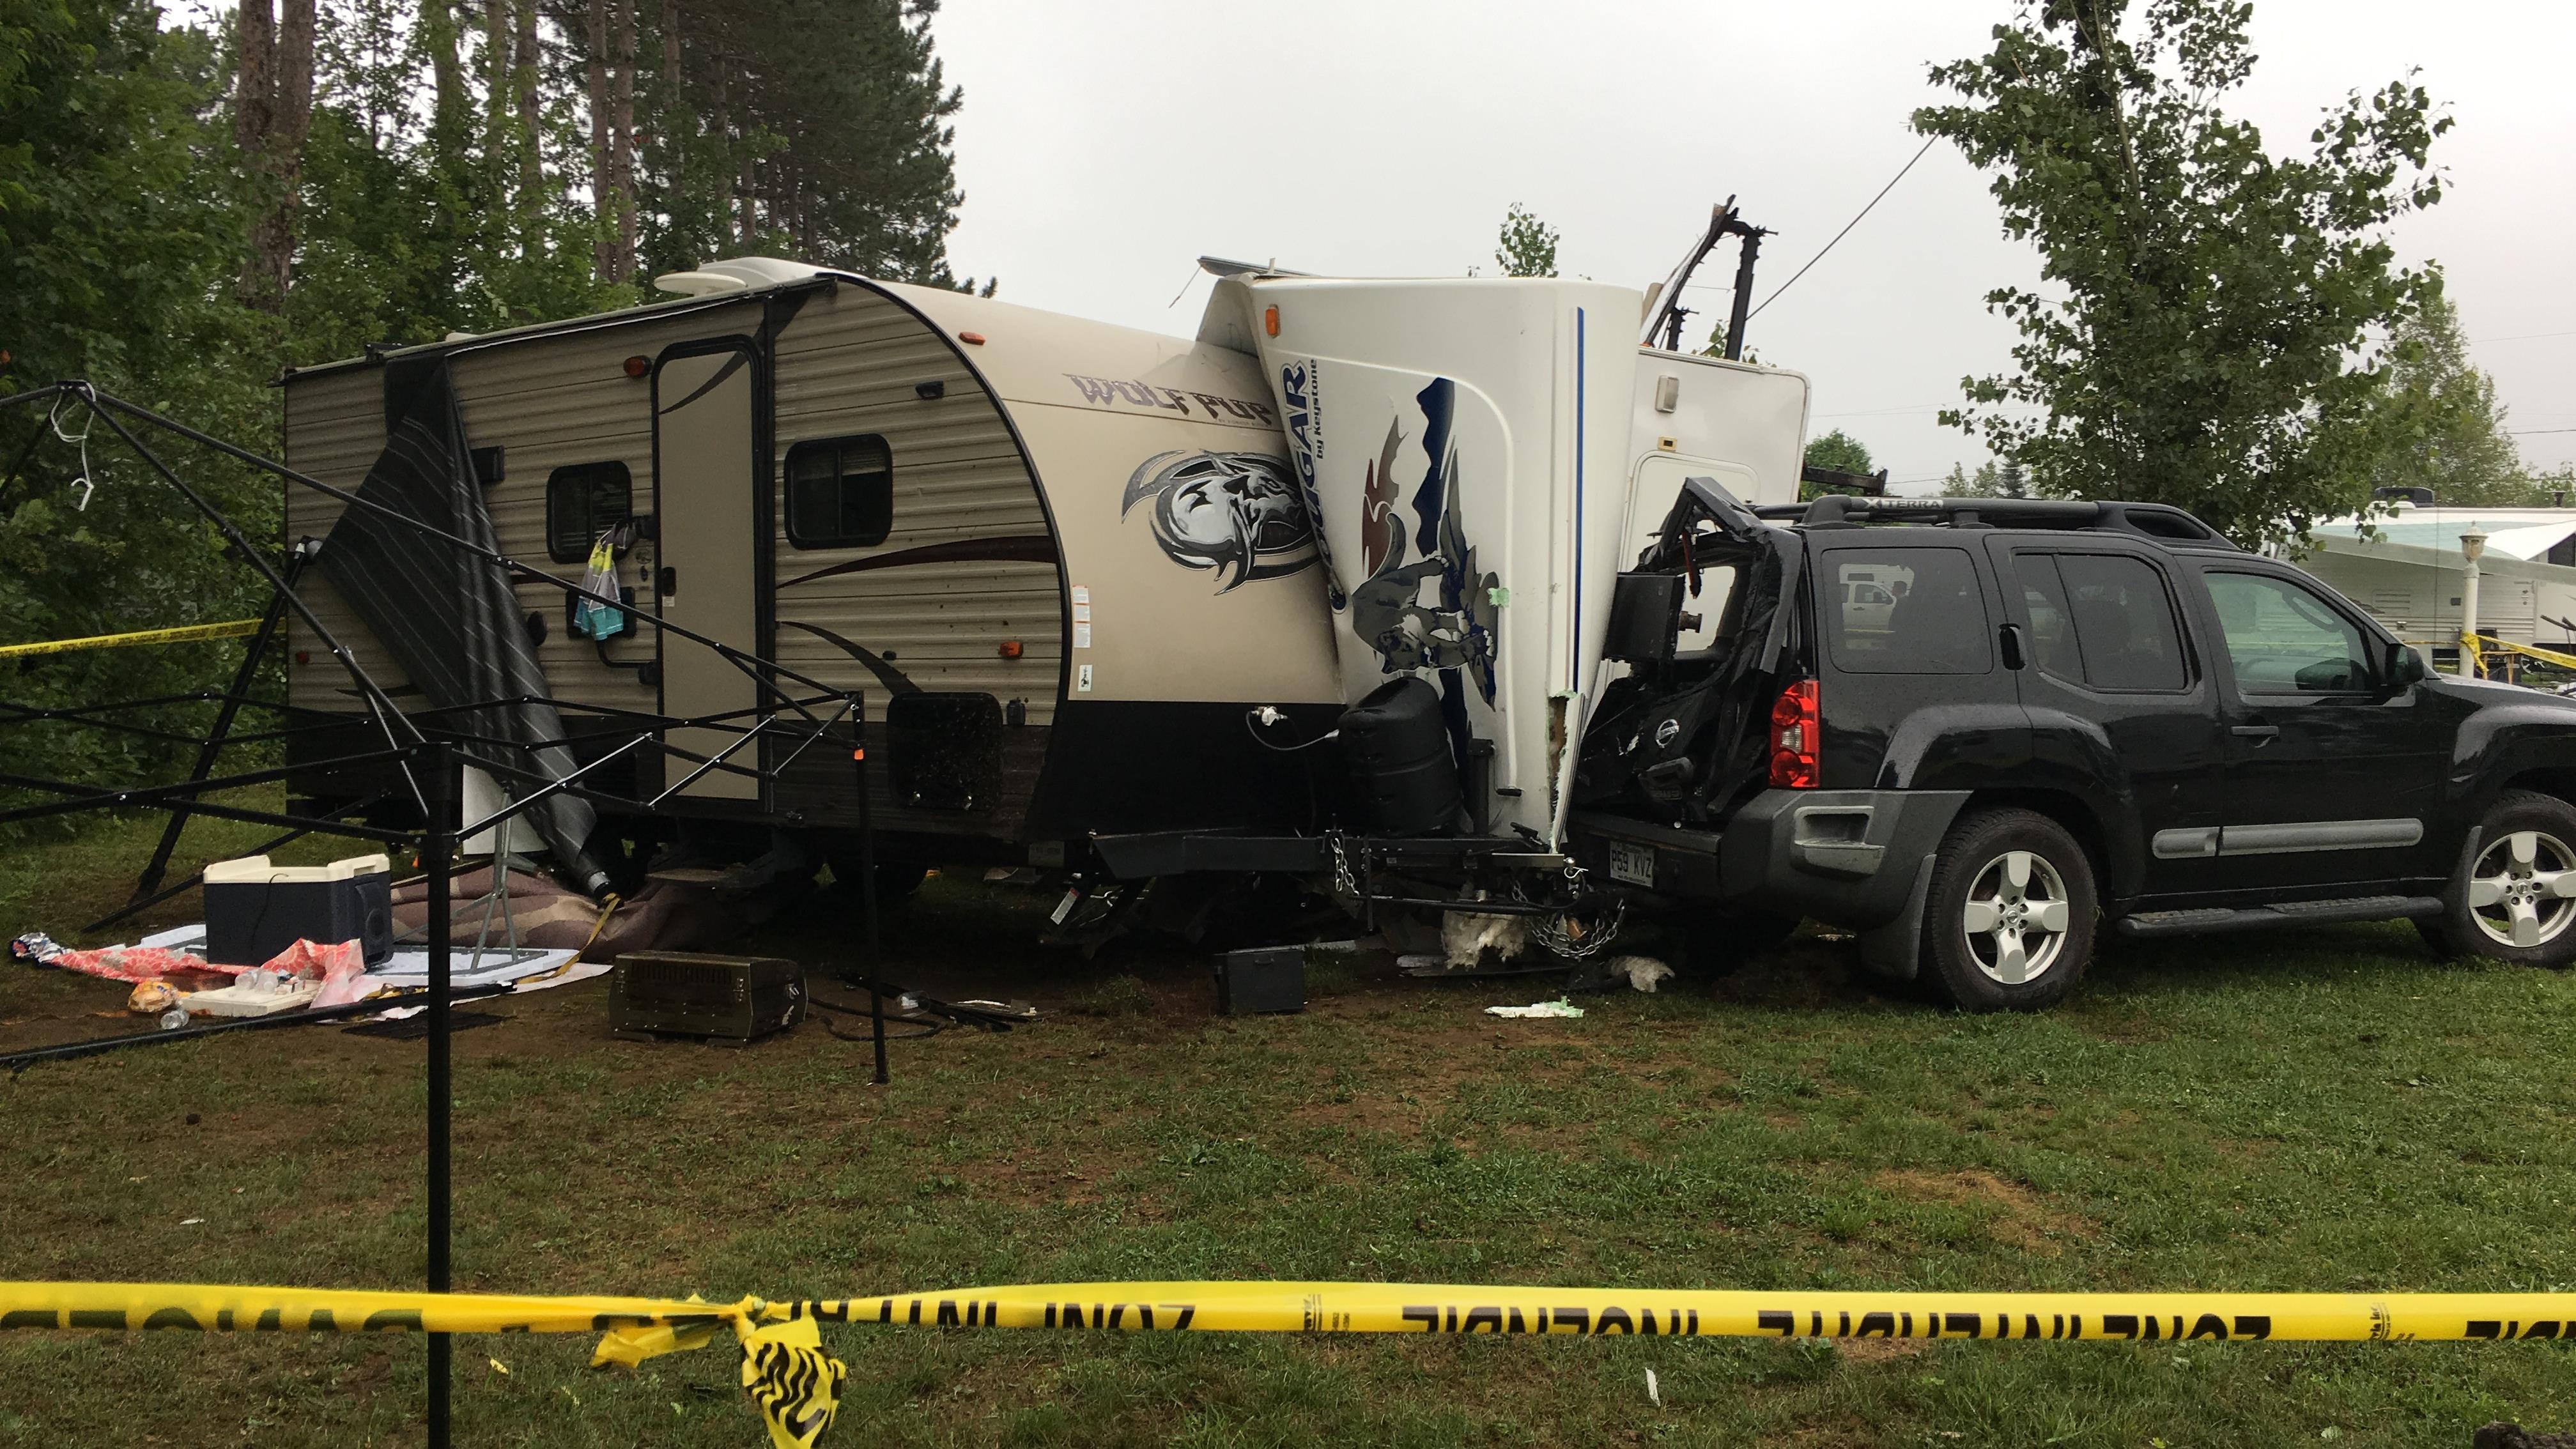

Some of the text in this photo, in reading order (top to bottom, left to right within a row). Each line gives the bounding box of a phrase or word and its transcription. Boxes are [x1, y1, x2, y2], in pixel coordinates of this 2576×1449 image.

[1061, 373, 1273, 426] WOLF PUP
[1311, 359, 1324, 459] by Keystone
[1281, 361, 1347, 613] OUGAR
[1634, 854, 1652, 878] KVZ
